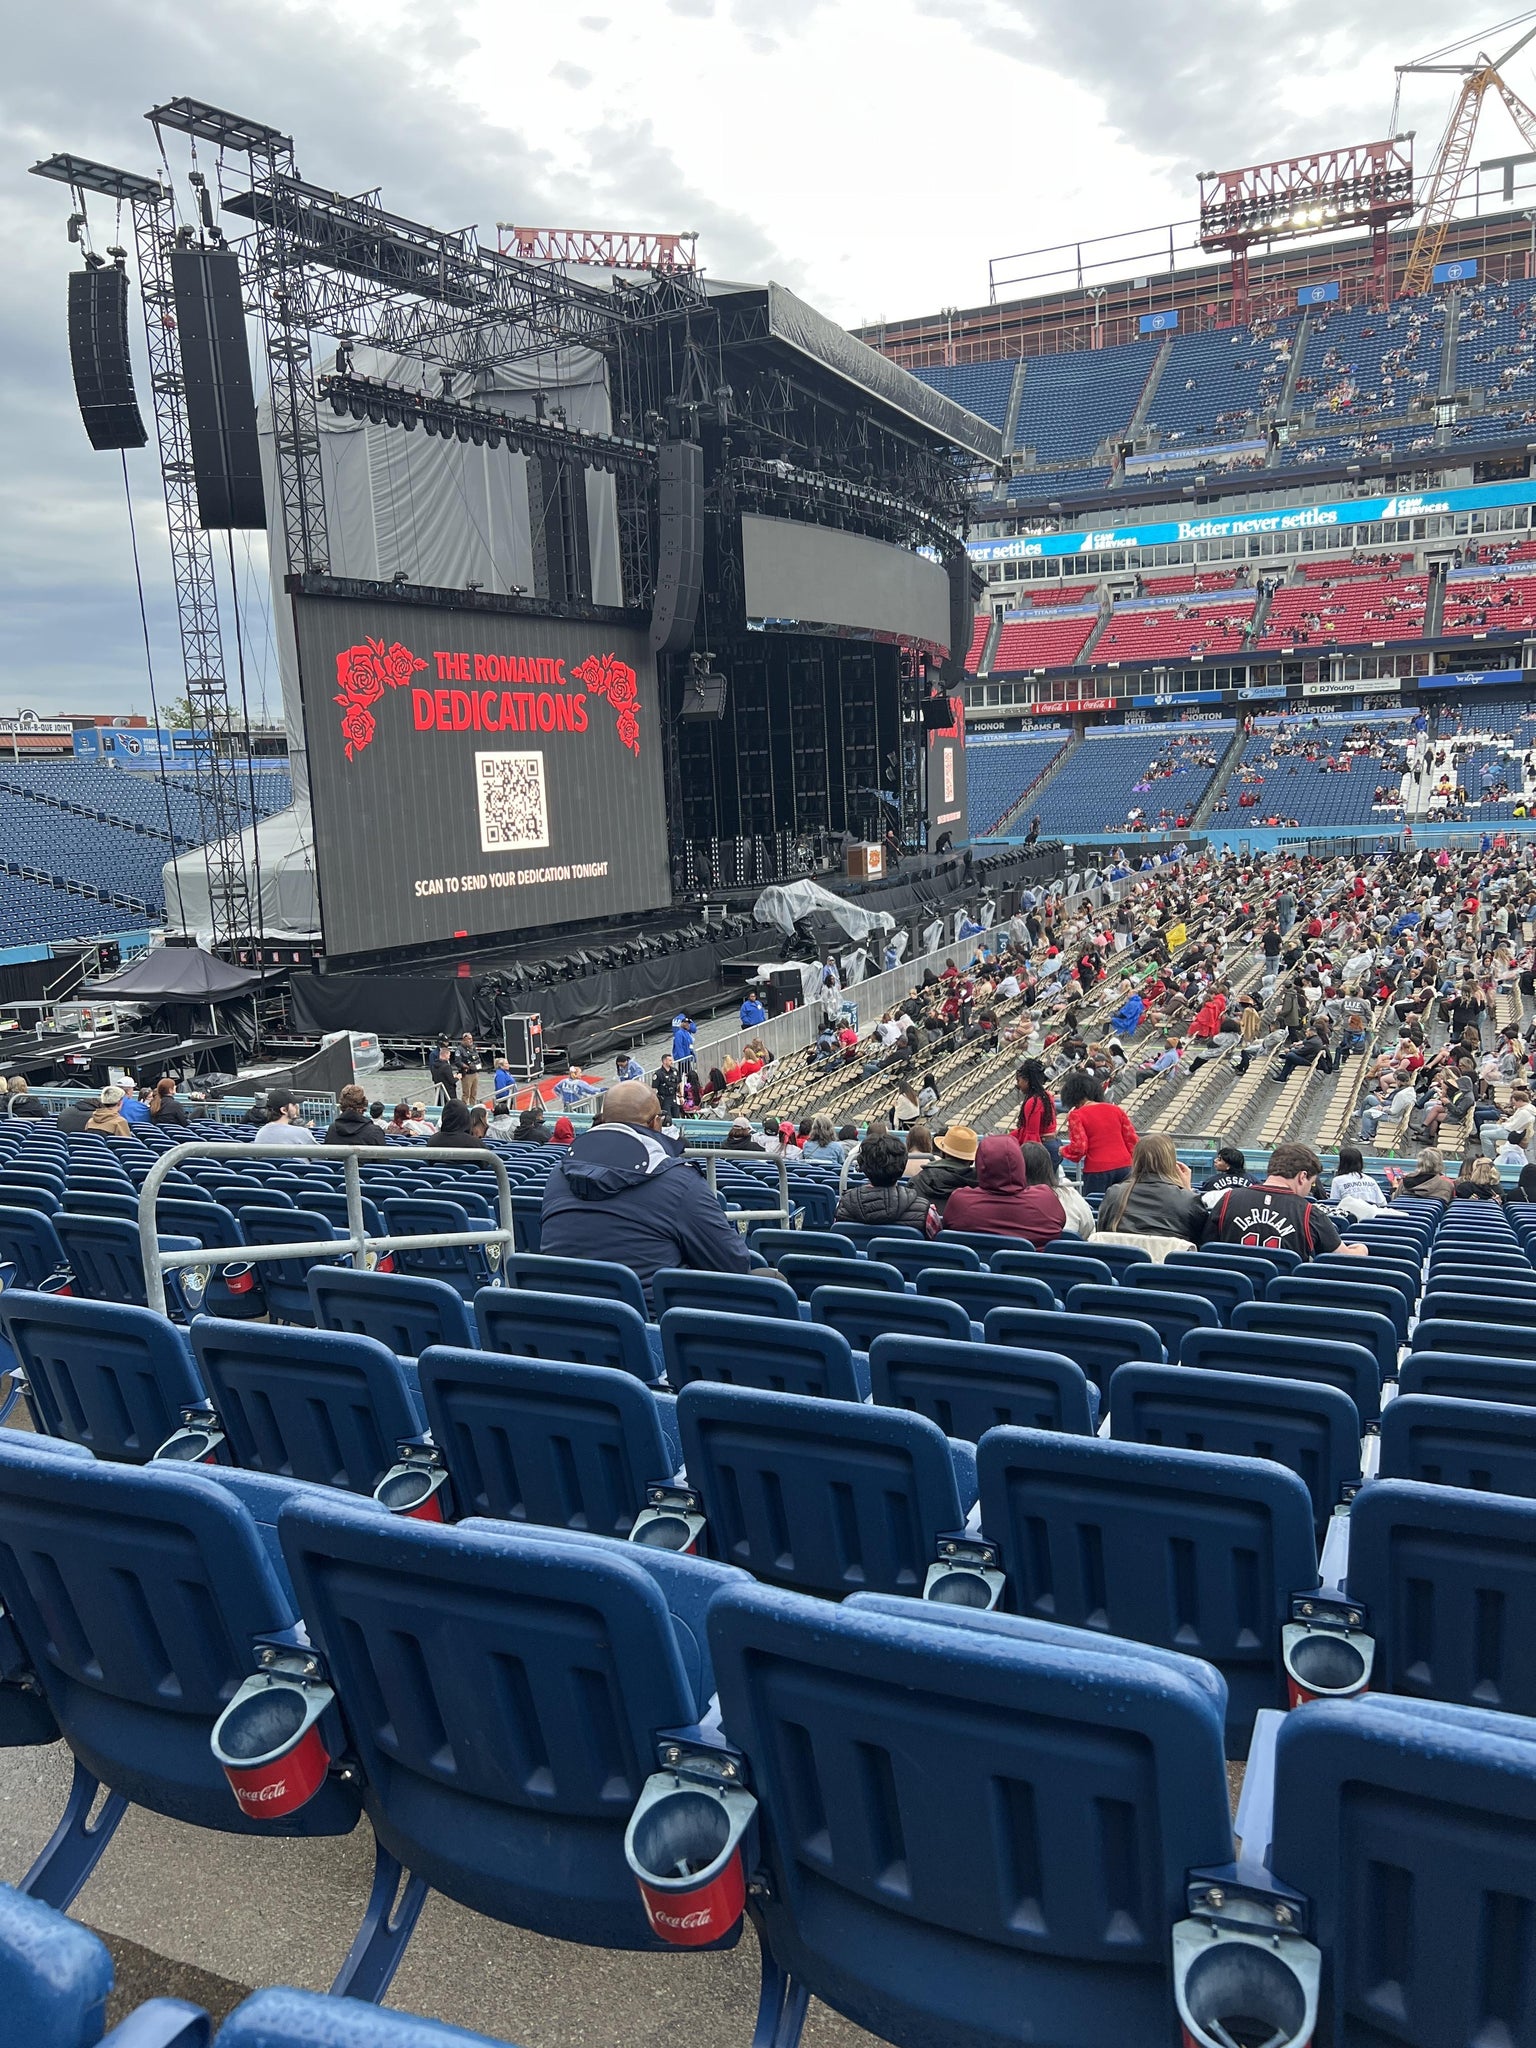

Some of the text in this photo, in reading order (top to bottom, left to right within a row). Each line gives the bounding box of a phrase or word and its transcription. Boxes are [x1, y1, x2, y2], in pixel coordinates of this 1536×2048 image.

[1178, 508, 1337, 539] Better never settles
[967, 540, 1042, 561] ver settles
[433, 652, 566, 685] THE ROMANTIC
[1320, 684, 1355, 692] RJYoung
[412, 688, 588, 733] DEDICATIONS
[1290, 704, 1335, 714] OUSTON
[974, 722, 1005, 731] HONOR
[415, 861, 609, 897] SCAN TO SEND YOUR DEDICATION TONIGHT
[238, 1779, 286, 1801] Coca-Cola
[655, 1907, 712, 1929] Coca-Cola
